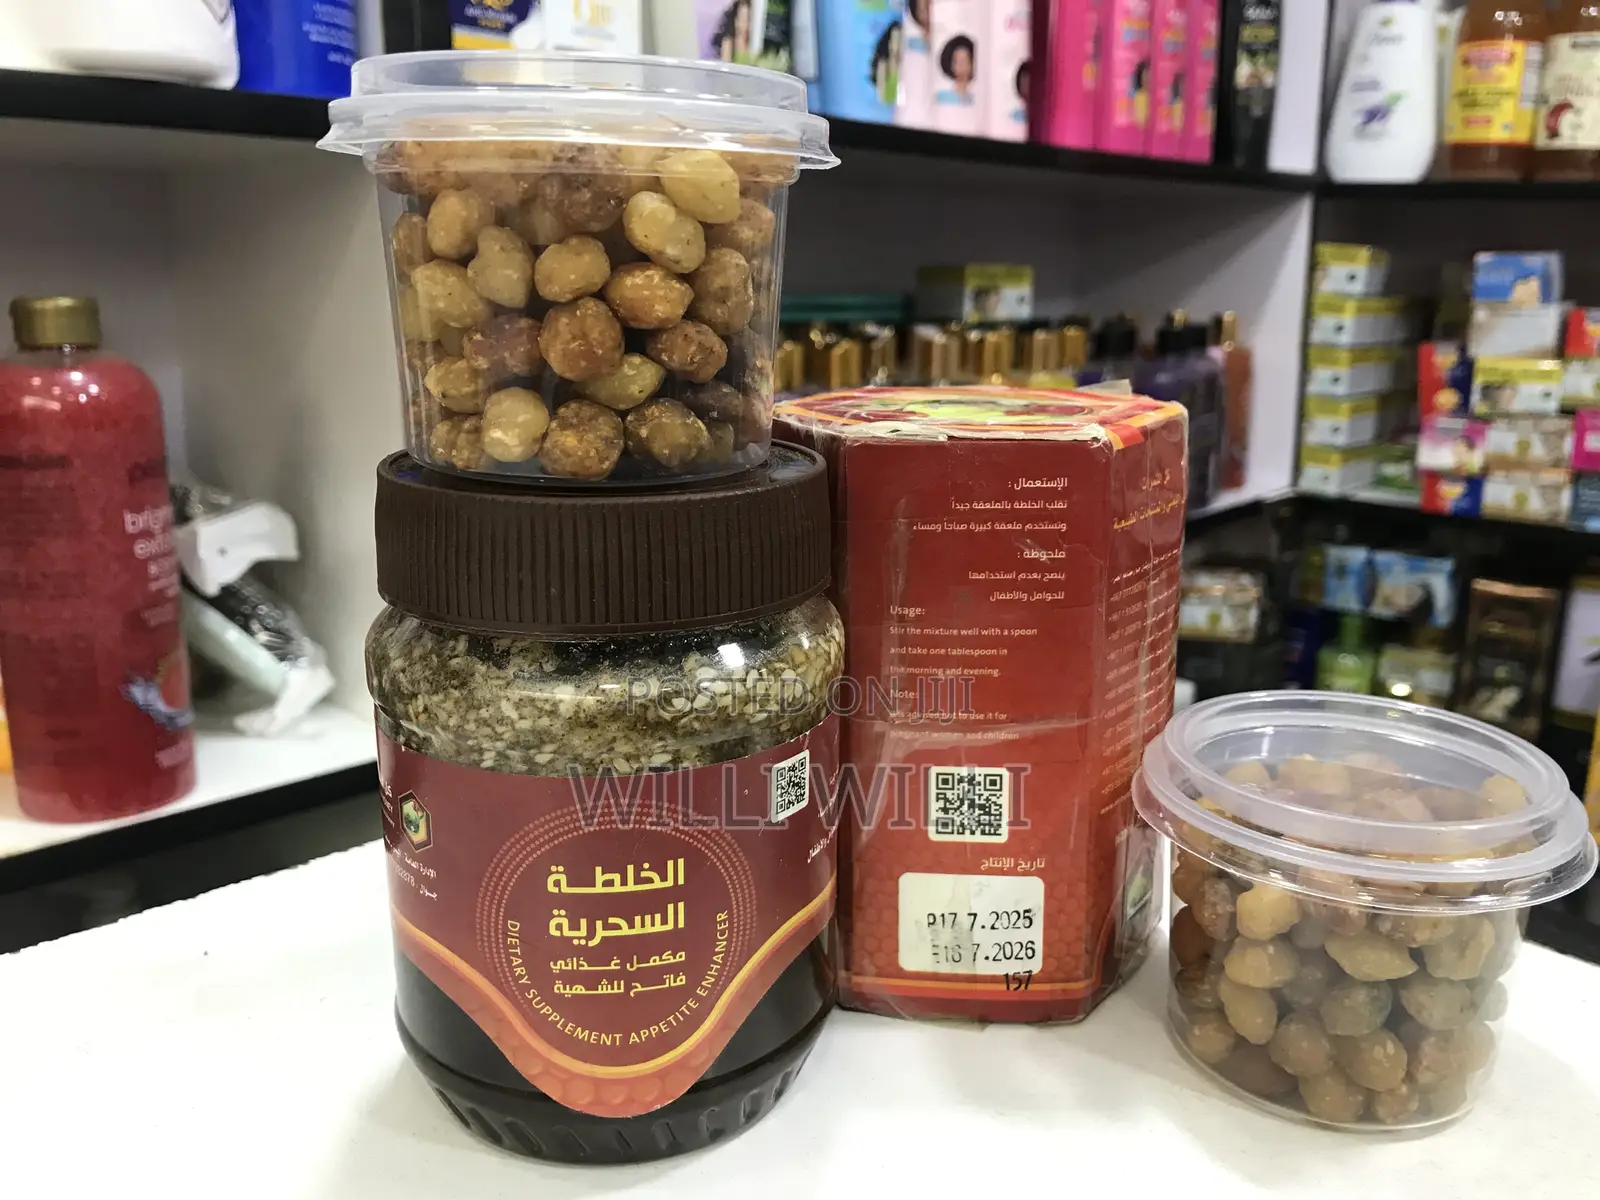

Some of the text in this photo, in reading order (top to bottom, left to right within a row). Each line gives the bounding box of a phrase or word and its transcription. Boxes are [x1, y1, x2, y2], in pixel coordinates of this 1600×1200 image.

[972, 500, 1011, 511] بالملعقة
[1013, 500, 1044, 509] الخلطة
[969, 521, 992, 532] كبيرة
[994, 521, 1022, 530] ملعقة
[1024, 521, 1067, 532] وتستخدم
[1023, 548, 1066, 561] ملحوظة
[968, 570, 1066, 581] ينصح بعدم استخدامها
[1029, 591, 1065, 602] للحوامل
[890, 605, 926, 617] Usage:
[890, 626, 905, 635] Stir
[907, 626, 922, 635] the
[923, 626, 958, 636] mixture
[960, 627, 979, 636] well
[980, 627, 1001, 636] with
[1011, 628, 1038, 637] spoon
[908, 647, 927, 655] take
[948, 647, 997, 657] tablespoon
[999, 648, 1008, 656] in
[907, 666, 944, 677] morning
[945, 667, 962, 675] and
[963, 667, 1001, 677] evening.
[968, 712, 985, 720] use
[987, 711, 995, 720] it
[996, 711, 1008, 720] for
[966, 731, 982, 740] and
[983, 731, 1019, 740] children
[980, 856, 1046, 872] تاريخ الإنتاج
[546, 857, 685, 894] الخلطة
[548, 901, 685, 947] السحرية
[549, 950, 686, 974] مكمل غذائي
[507, 909, 729, 1046] DIETARY SUPPLEMENT APPETITE ENHANCER
[1003, 970, 1033, 992] 157
[553, 972, 686, 998] فاتح للشهية
